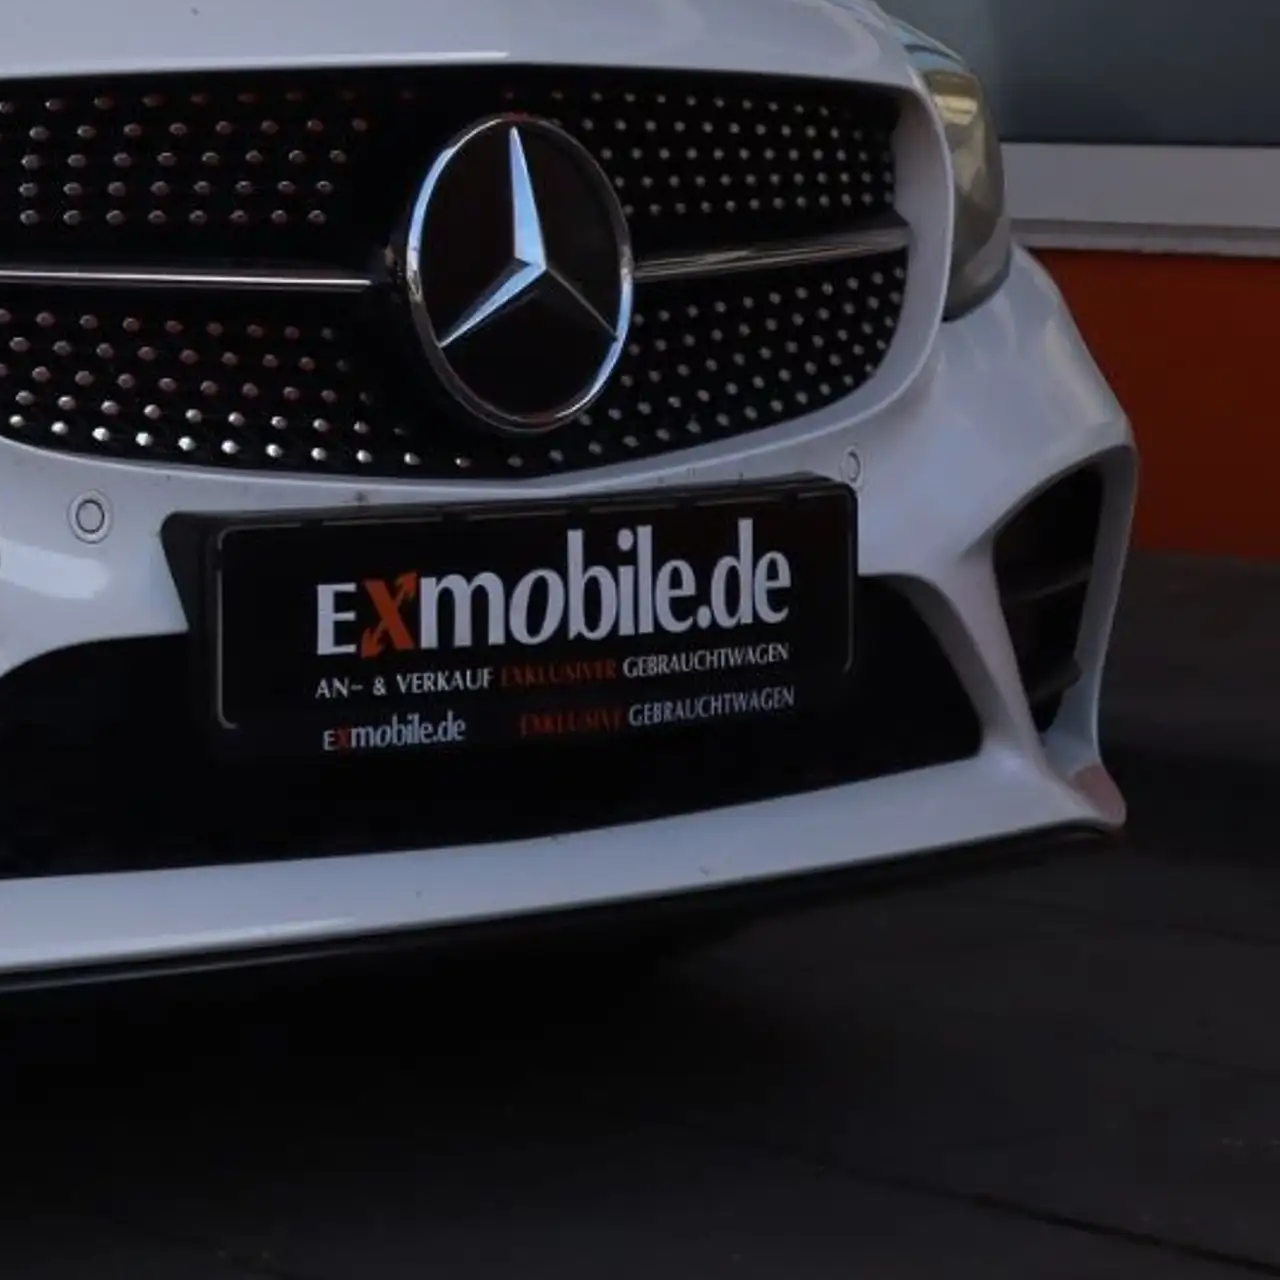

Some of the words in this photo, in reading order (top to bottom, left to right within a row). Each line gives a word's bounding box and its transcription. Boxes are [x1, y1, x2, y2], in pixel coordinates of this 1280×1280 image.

[314, 676, 364, 700] AN-
[371, 675, 389, 698] &
[395, 667, 496, 695] VERKAUF
[621, 642, 791, 680] GEBRAUCHTWAGEN
[628, 685, 796, 728] GEBRAUCHTWAGEN
